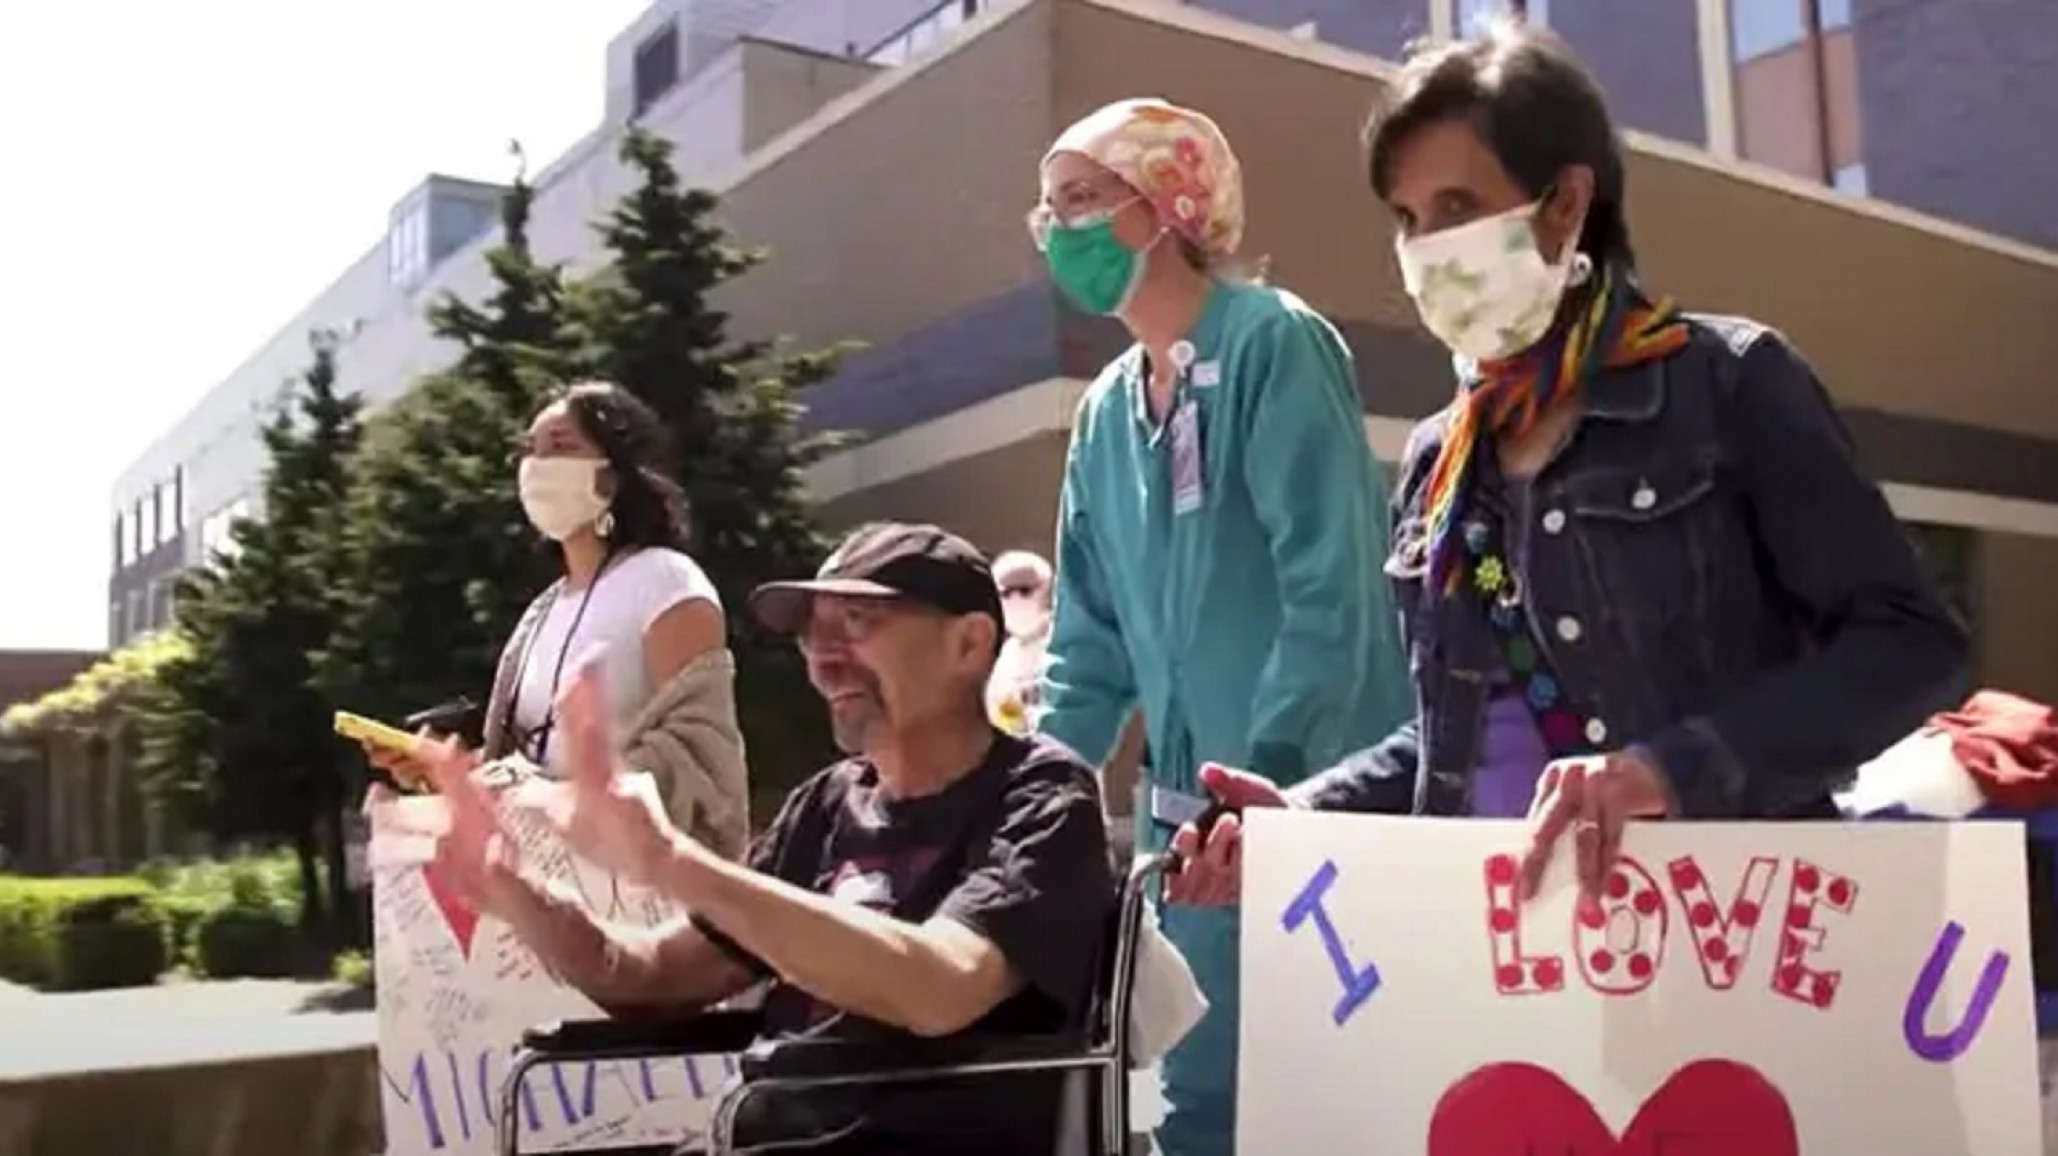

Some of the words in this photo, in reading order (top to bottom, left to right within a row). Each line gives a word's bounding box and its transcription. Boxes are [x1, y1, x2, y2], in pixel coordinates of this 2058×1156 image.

[1282, 859, 1382, 1027] I
[1484, 853, 1858, 1010] LOVE
[1903, 921, 2011, 1063] U
